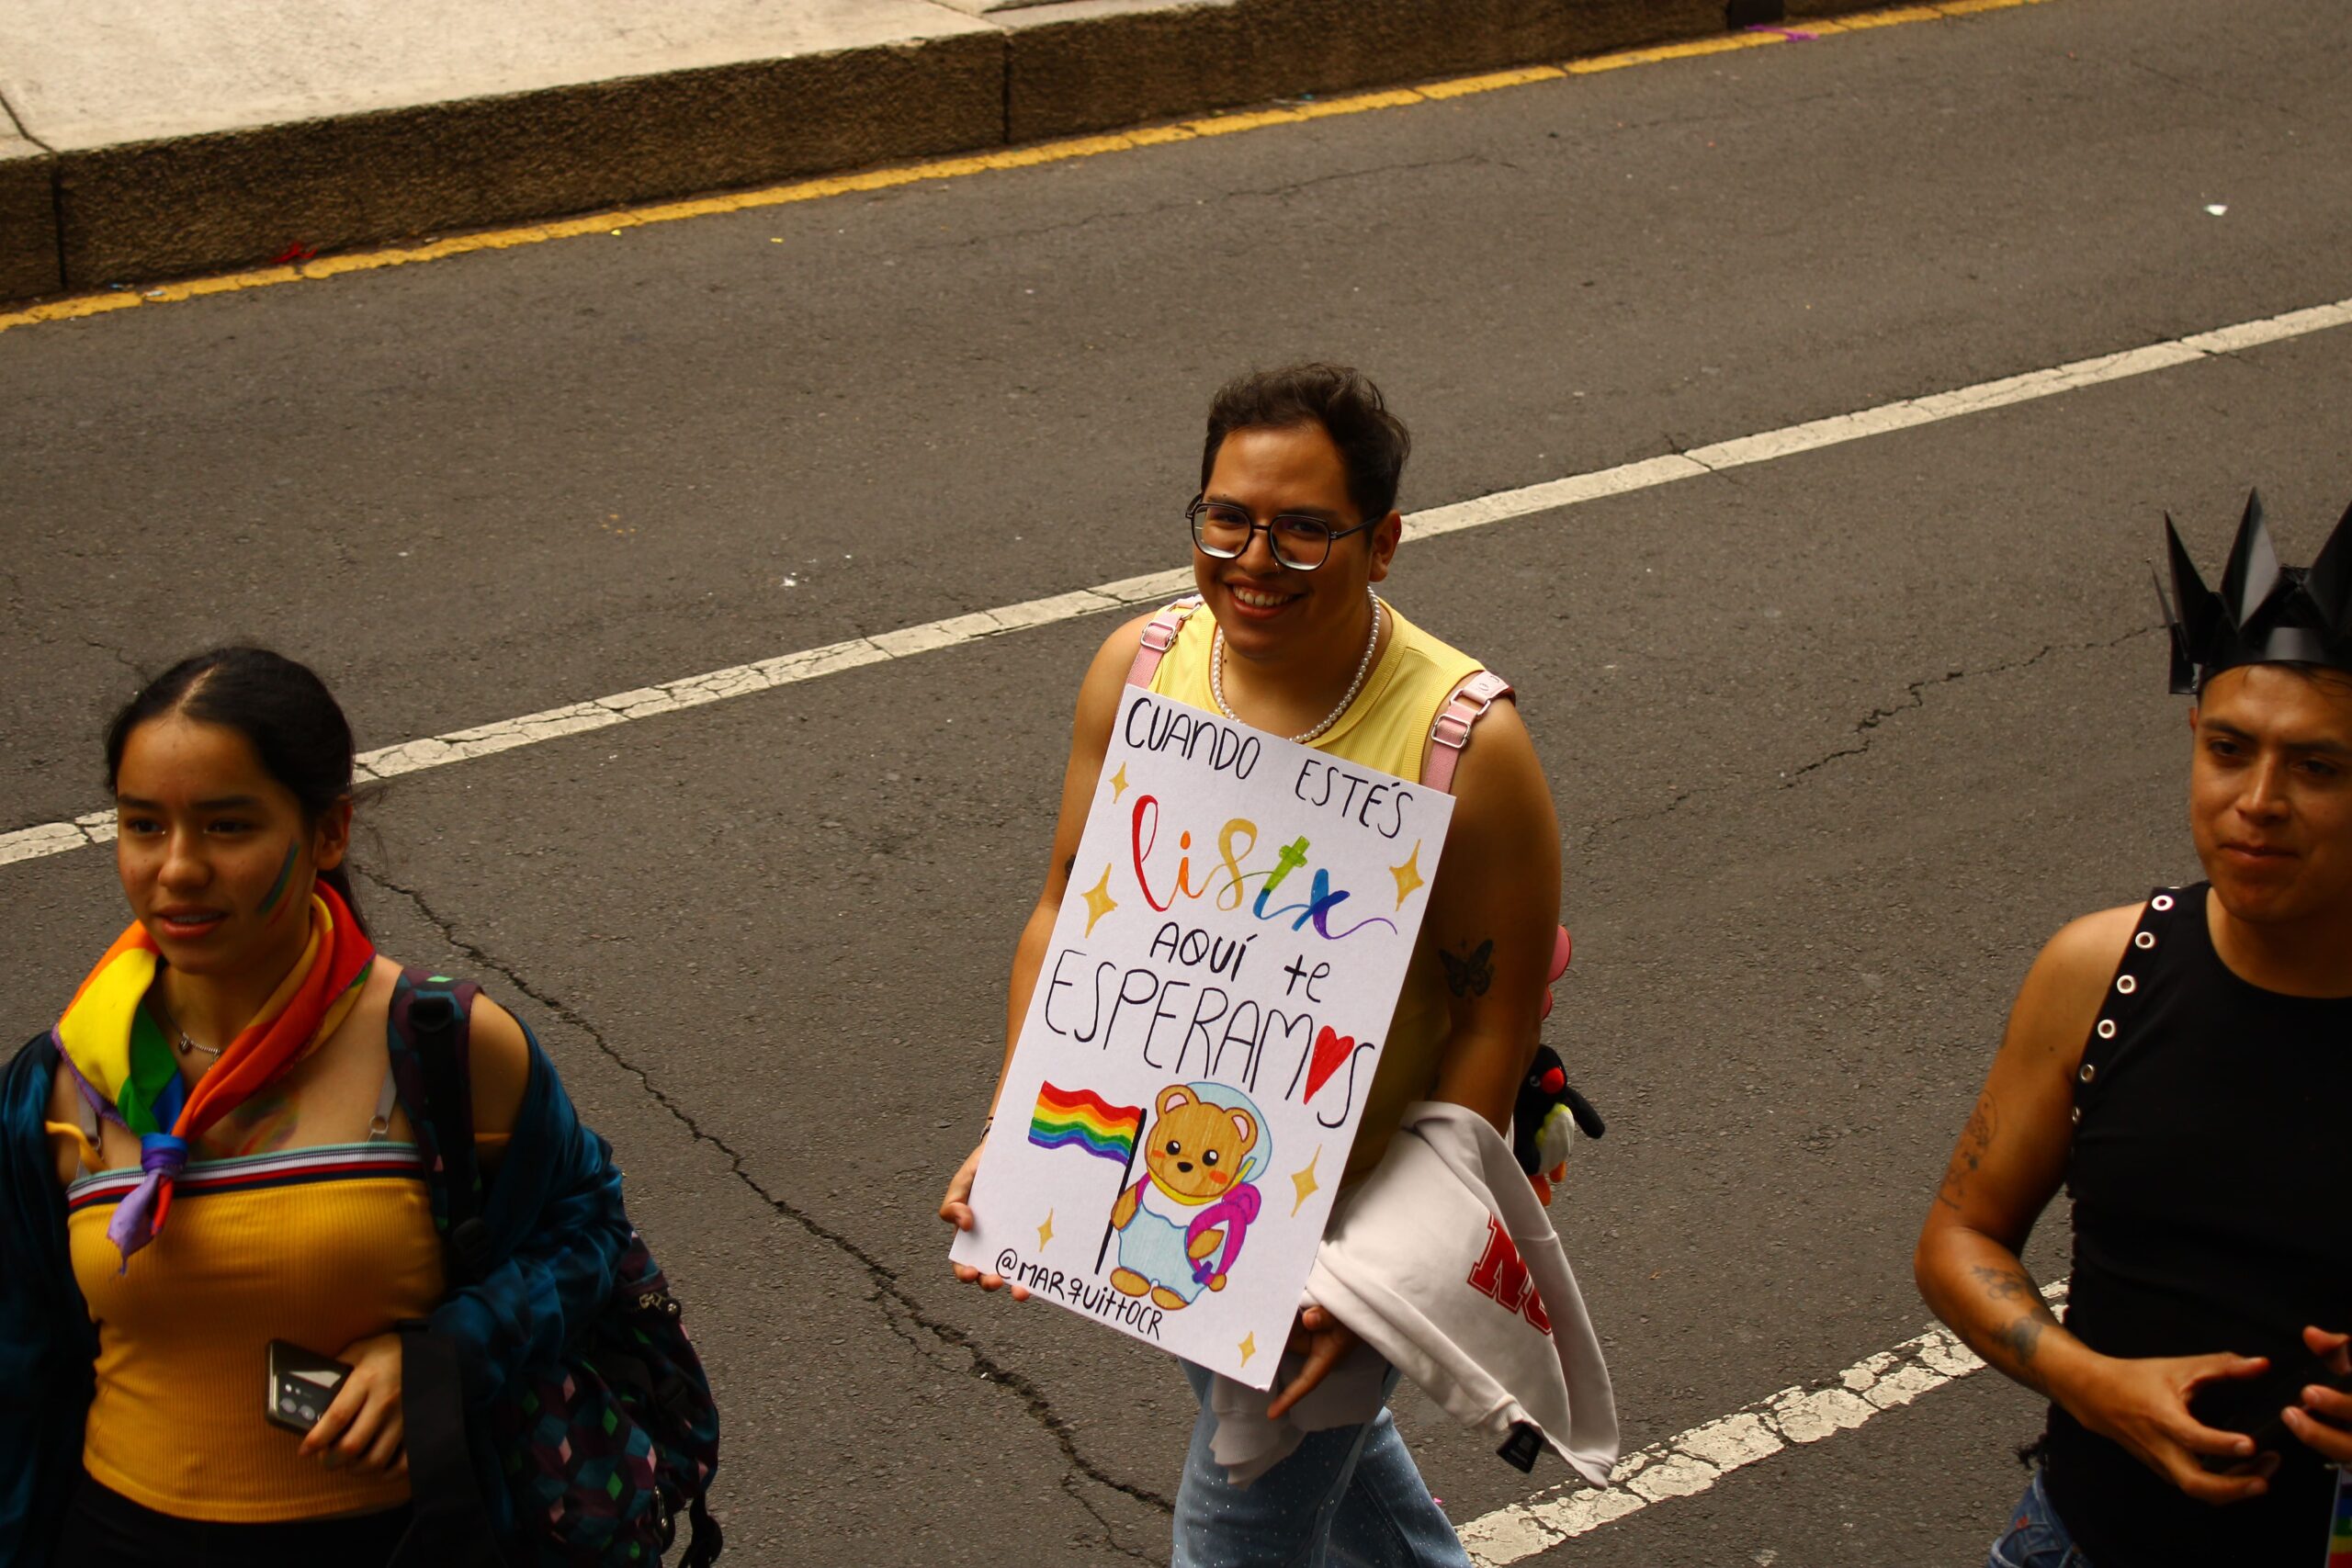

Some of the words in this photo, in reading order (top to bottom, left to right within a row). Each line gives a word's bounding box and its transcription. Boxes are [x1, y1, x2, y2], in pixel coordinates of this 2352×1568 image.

[1125, 697, 1261, 780] CUANDO
[1295, 759, 1413, 839] ESTÉS
[1149, 921, 1259, 982] AQUÍ
[1283, 954, 1330, 1003] te
